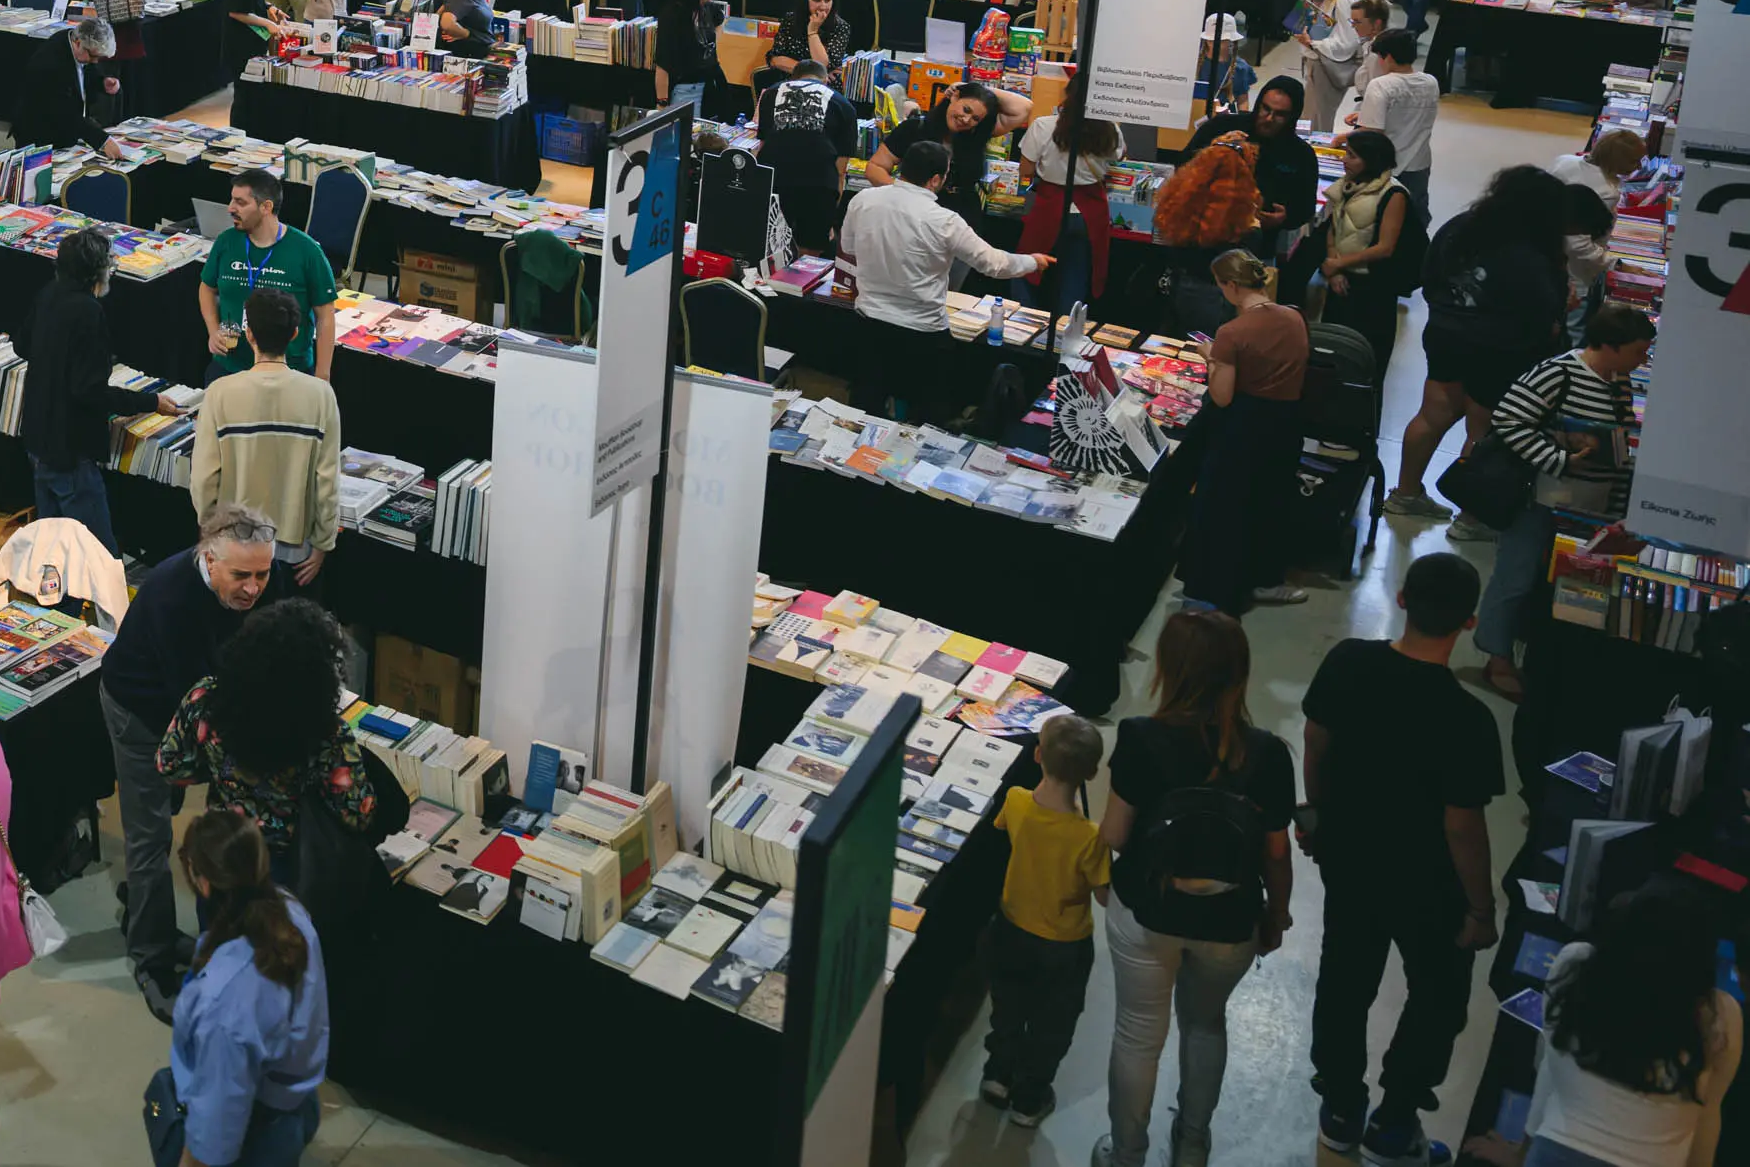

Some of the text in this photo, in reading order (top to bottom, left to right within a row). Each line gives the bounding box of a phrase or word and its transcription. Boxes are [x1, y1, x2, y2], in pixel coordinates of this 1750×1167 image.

[612, 150, 648, 267] 3
[650, 220, 670, 250] 46
[651, 190, 663, 219] C
[1684, 182, 1750, 299] 3
